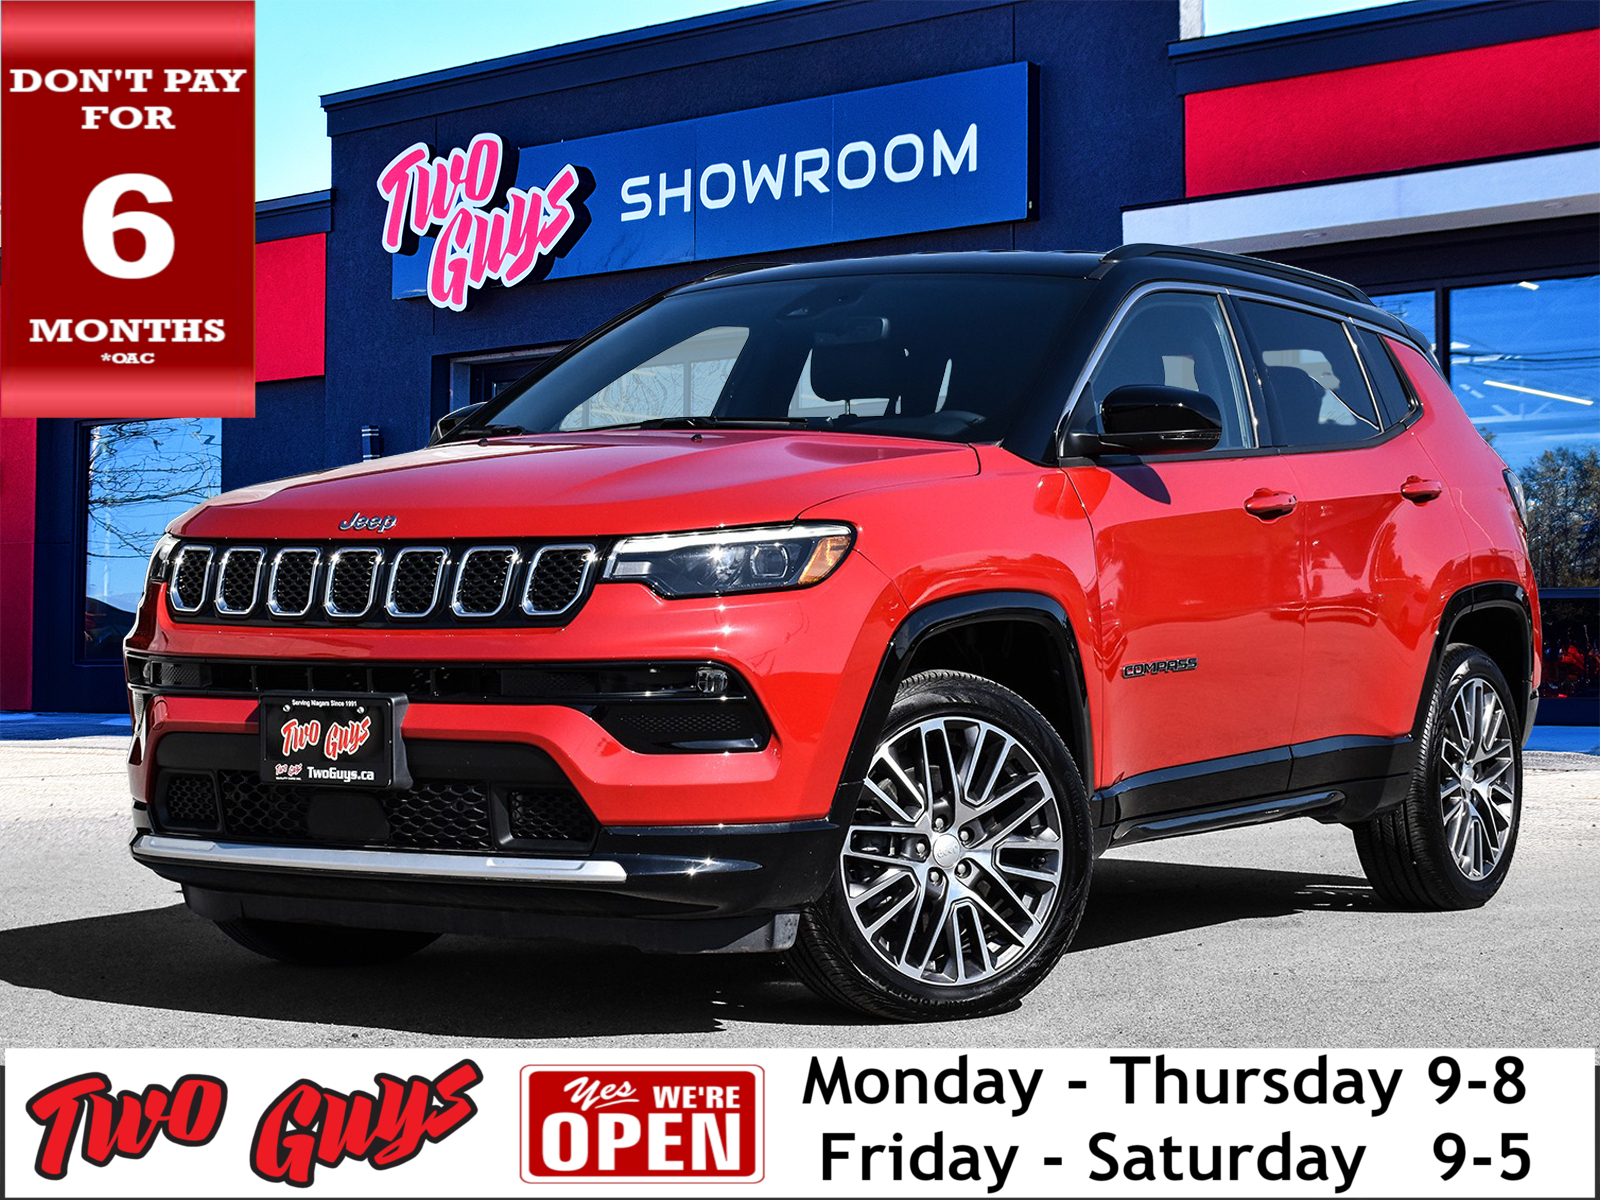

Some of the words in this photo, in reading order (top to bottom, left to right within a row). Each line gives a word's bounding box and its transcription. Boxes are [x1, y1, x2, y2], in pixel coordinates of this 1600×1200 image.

[621, 124, 977, 221] SHOWROOM
[339, 511, 397, 533] Jeep
[1123, 657, 1198, 679] COMPASS
[292, 699, 310, 707] Serving
[281, 718, 321, 756] Two
[324, 716, 371, 760] Guys
[307, 766, 375, 782] TwoGuys.ca
